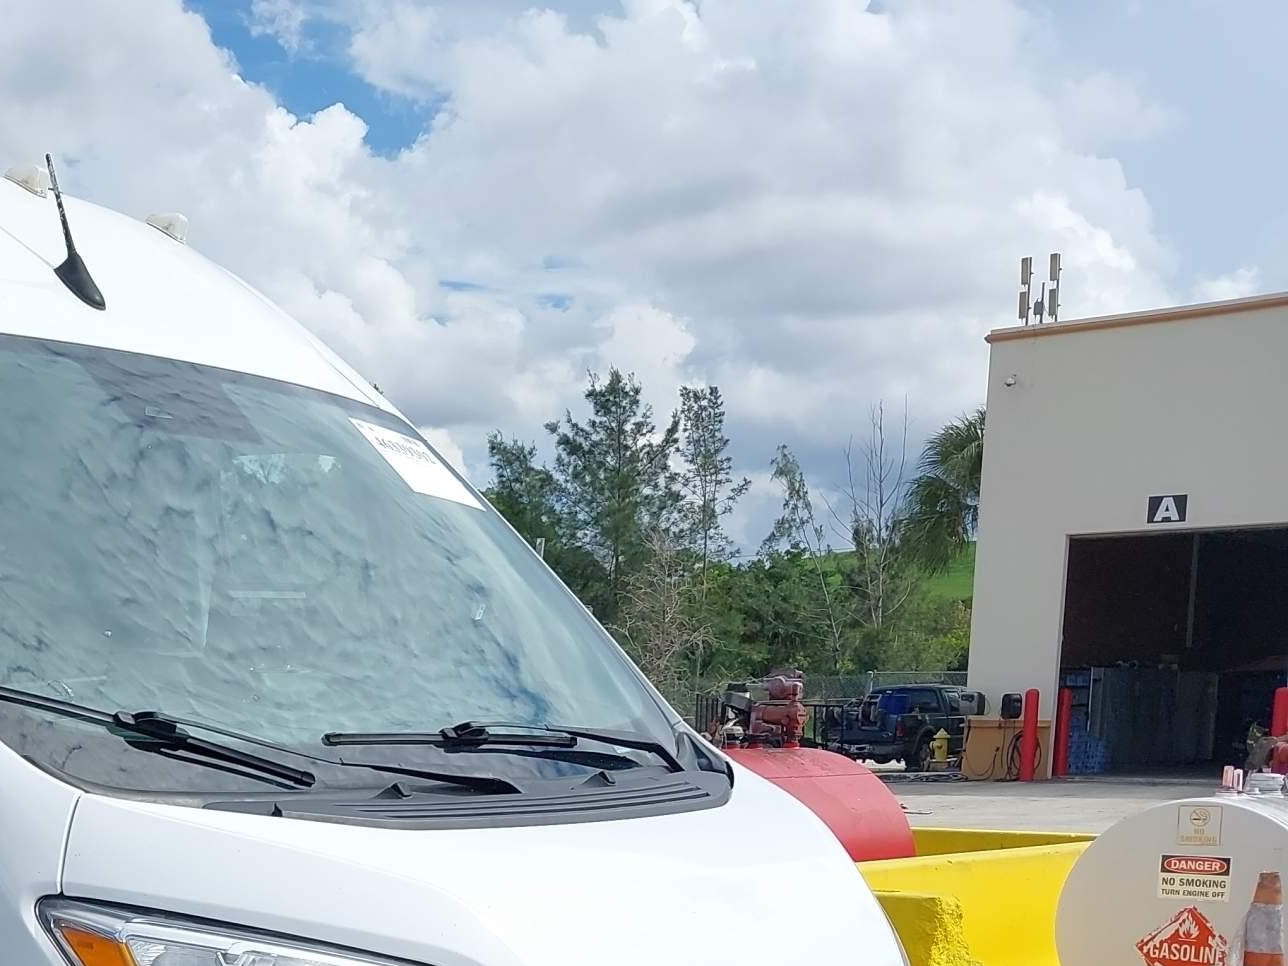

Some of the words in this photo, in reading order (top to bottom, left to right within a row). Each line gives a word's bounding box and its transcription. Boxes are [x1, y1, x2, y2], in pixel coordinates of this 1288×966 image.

[1153, 497, 1180, 521] A
[1171, 860, 1220, 871] DANGER
[1161, 877, 1175, 886] NO
[1179, 878, 1226, 889] SMOKING
[1161, 888, 1180, 896] TURN
[1182, 890, 1209, 898] ENGINE
[1149, 942, 1224, 964] GASOLINE
